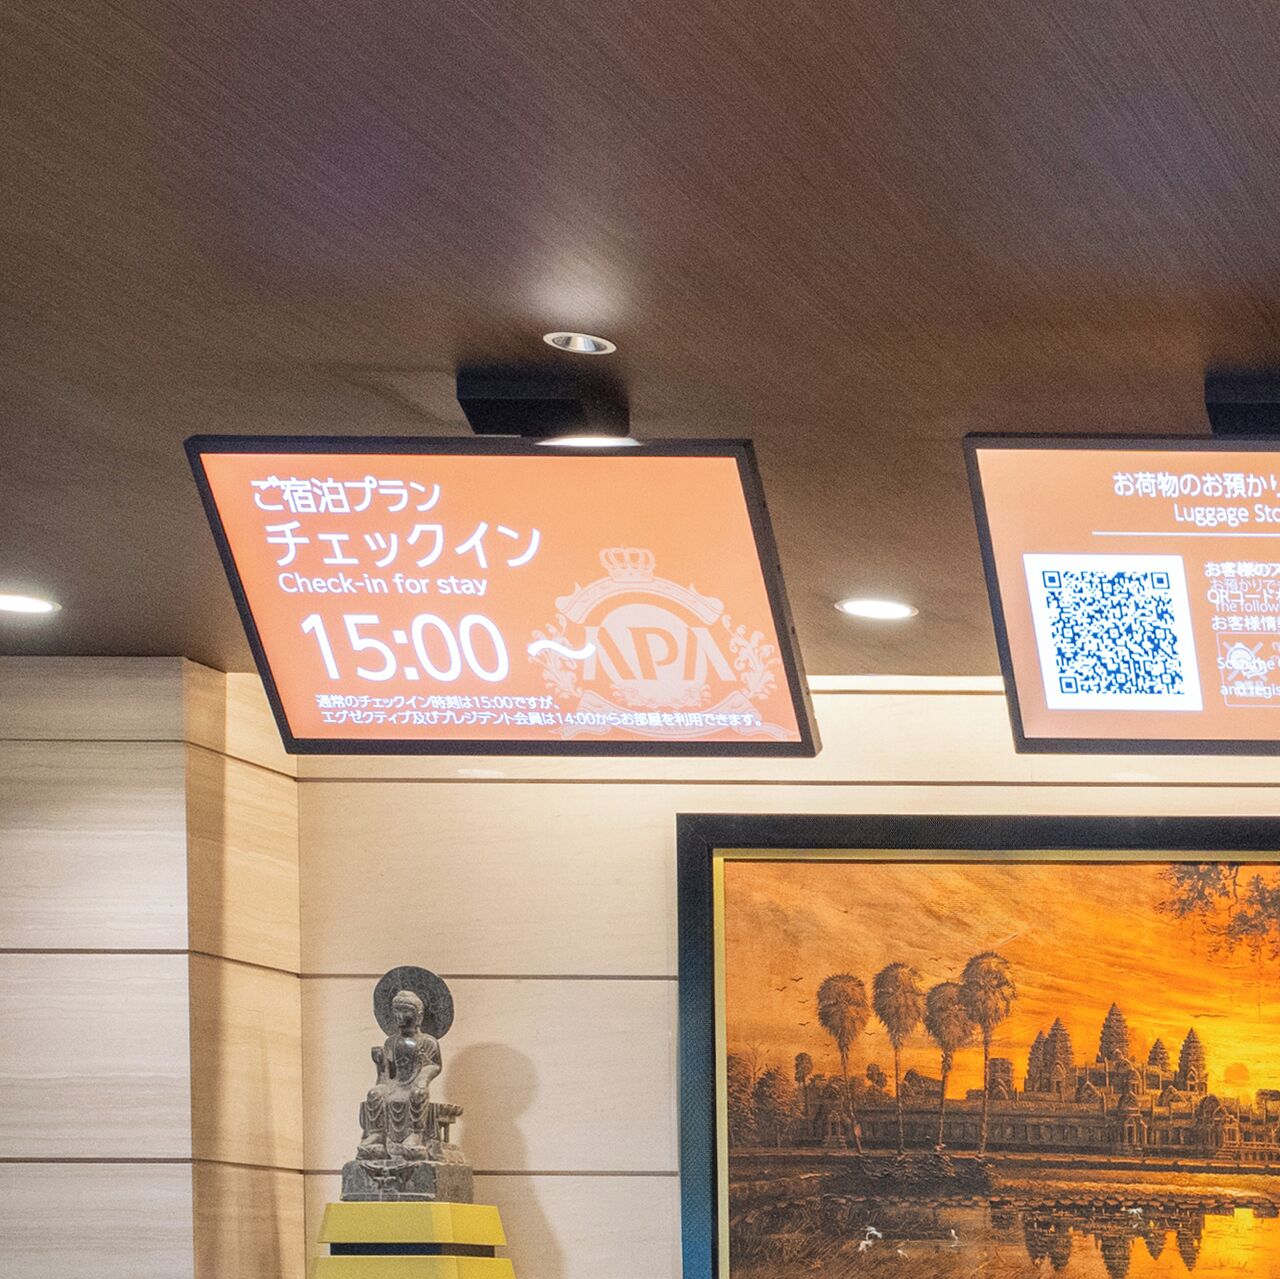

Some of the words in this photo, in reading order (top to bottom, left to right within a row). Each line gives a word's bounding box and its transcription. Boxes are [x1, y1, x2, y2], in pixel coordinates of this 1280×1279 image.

[250, 475, 441, 514] ご宿泊プラン
[1174, 503, 1249, 526] Luggage
[265, 521, 540, 569] チェックイン
[278, 573, 388, 595] Check-in
[393, 573, 430, 594] for
[437, 577, 488, 598] stay
[301, 613, 509, 682] 15:00
